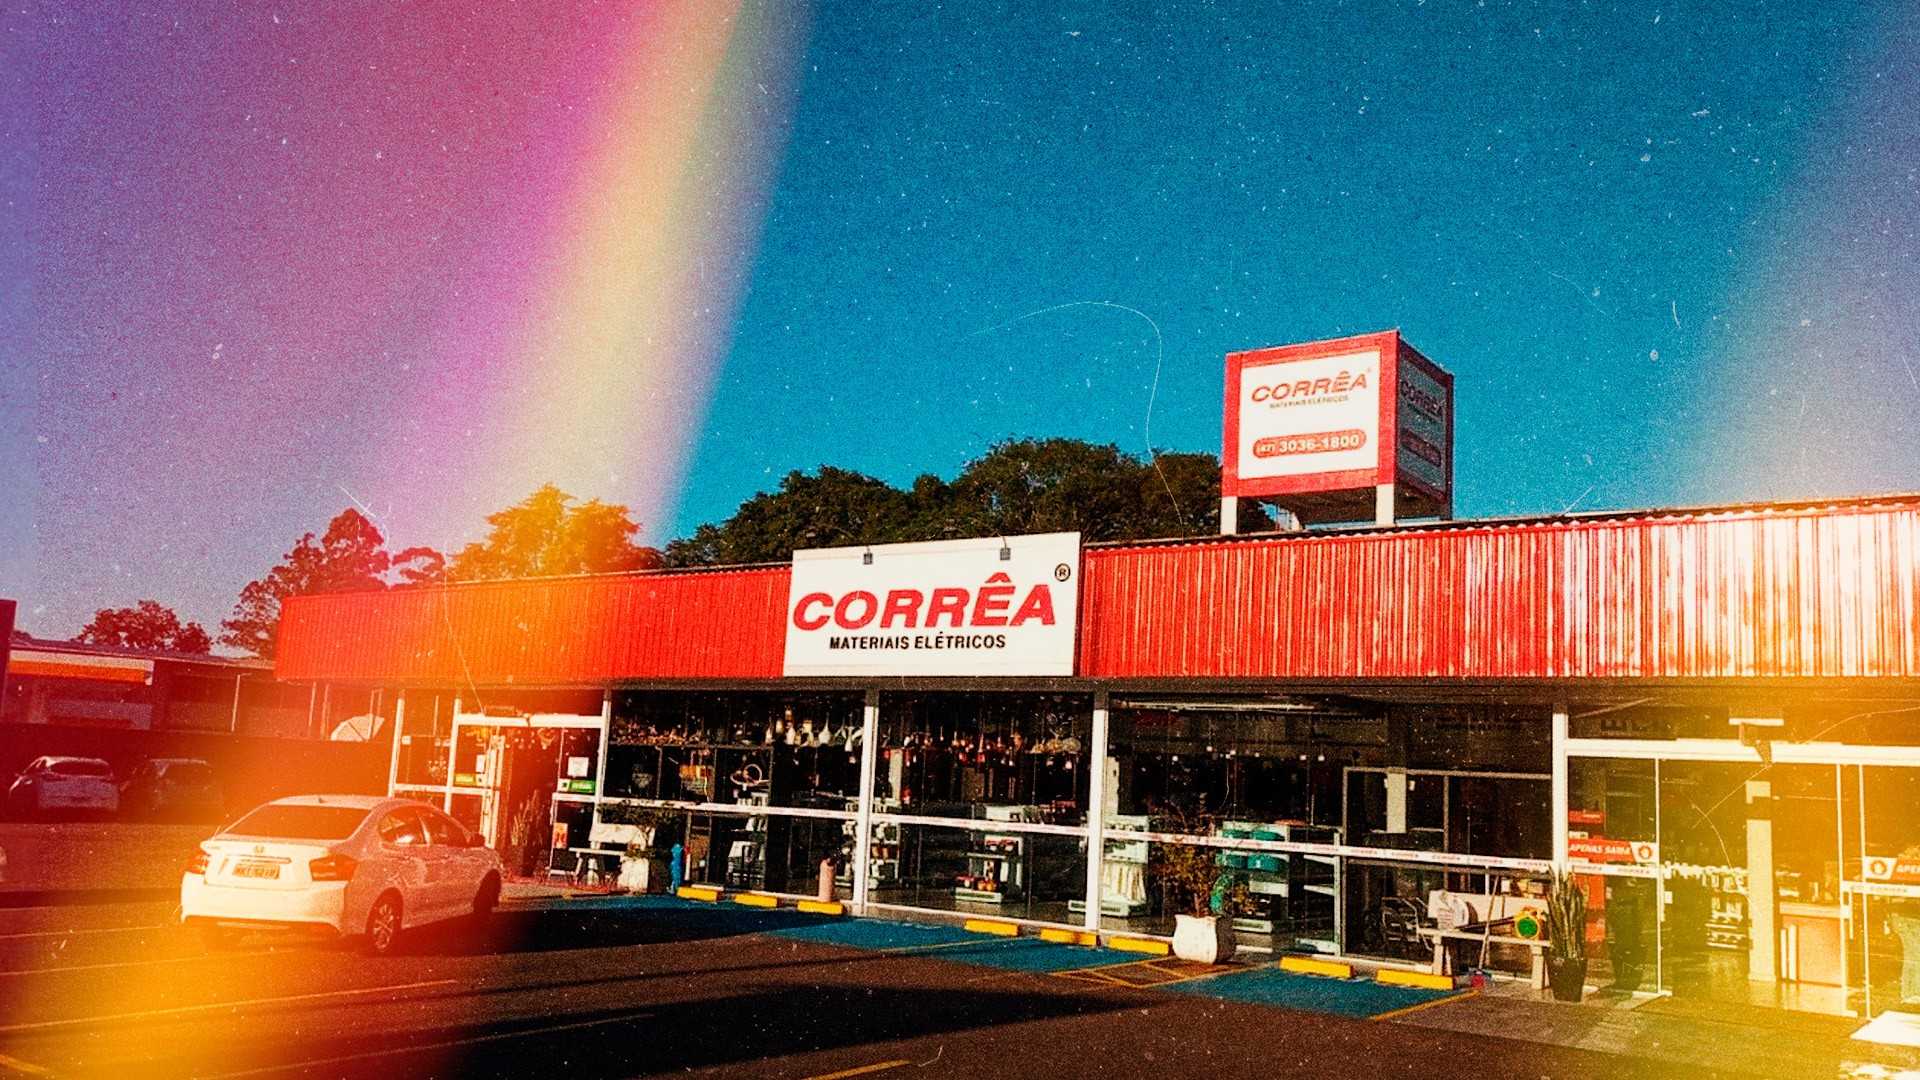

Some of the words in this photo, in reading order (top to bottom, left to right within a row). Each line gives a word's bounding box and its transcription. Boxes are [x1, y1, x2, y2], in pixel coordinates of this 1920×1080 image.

[1251, 370, 1368, 402] CORRÊA
[1279, 433, 1360, 453] 3036-1800
[793, 572, 1056, 631] CORRÊA
[829, 635, 910, 650] MATERIAIS
[914, 631, 1006, 649] ELÉTRICOS
